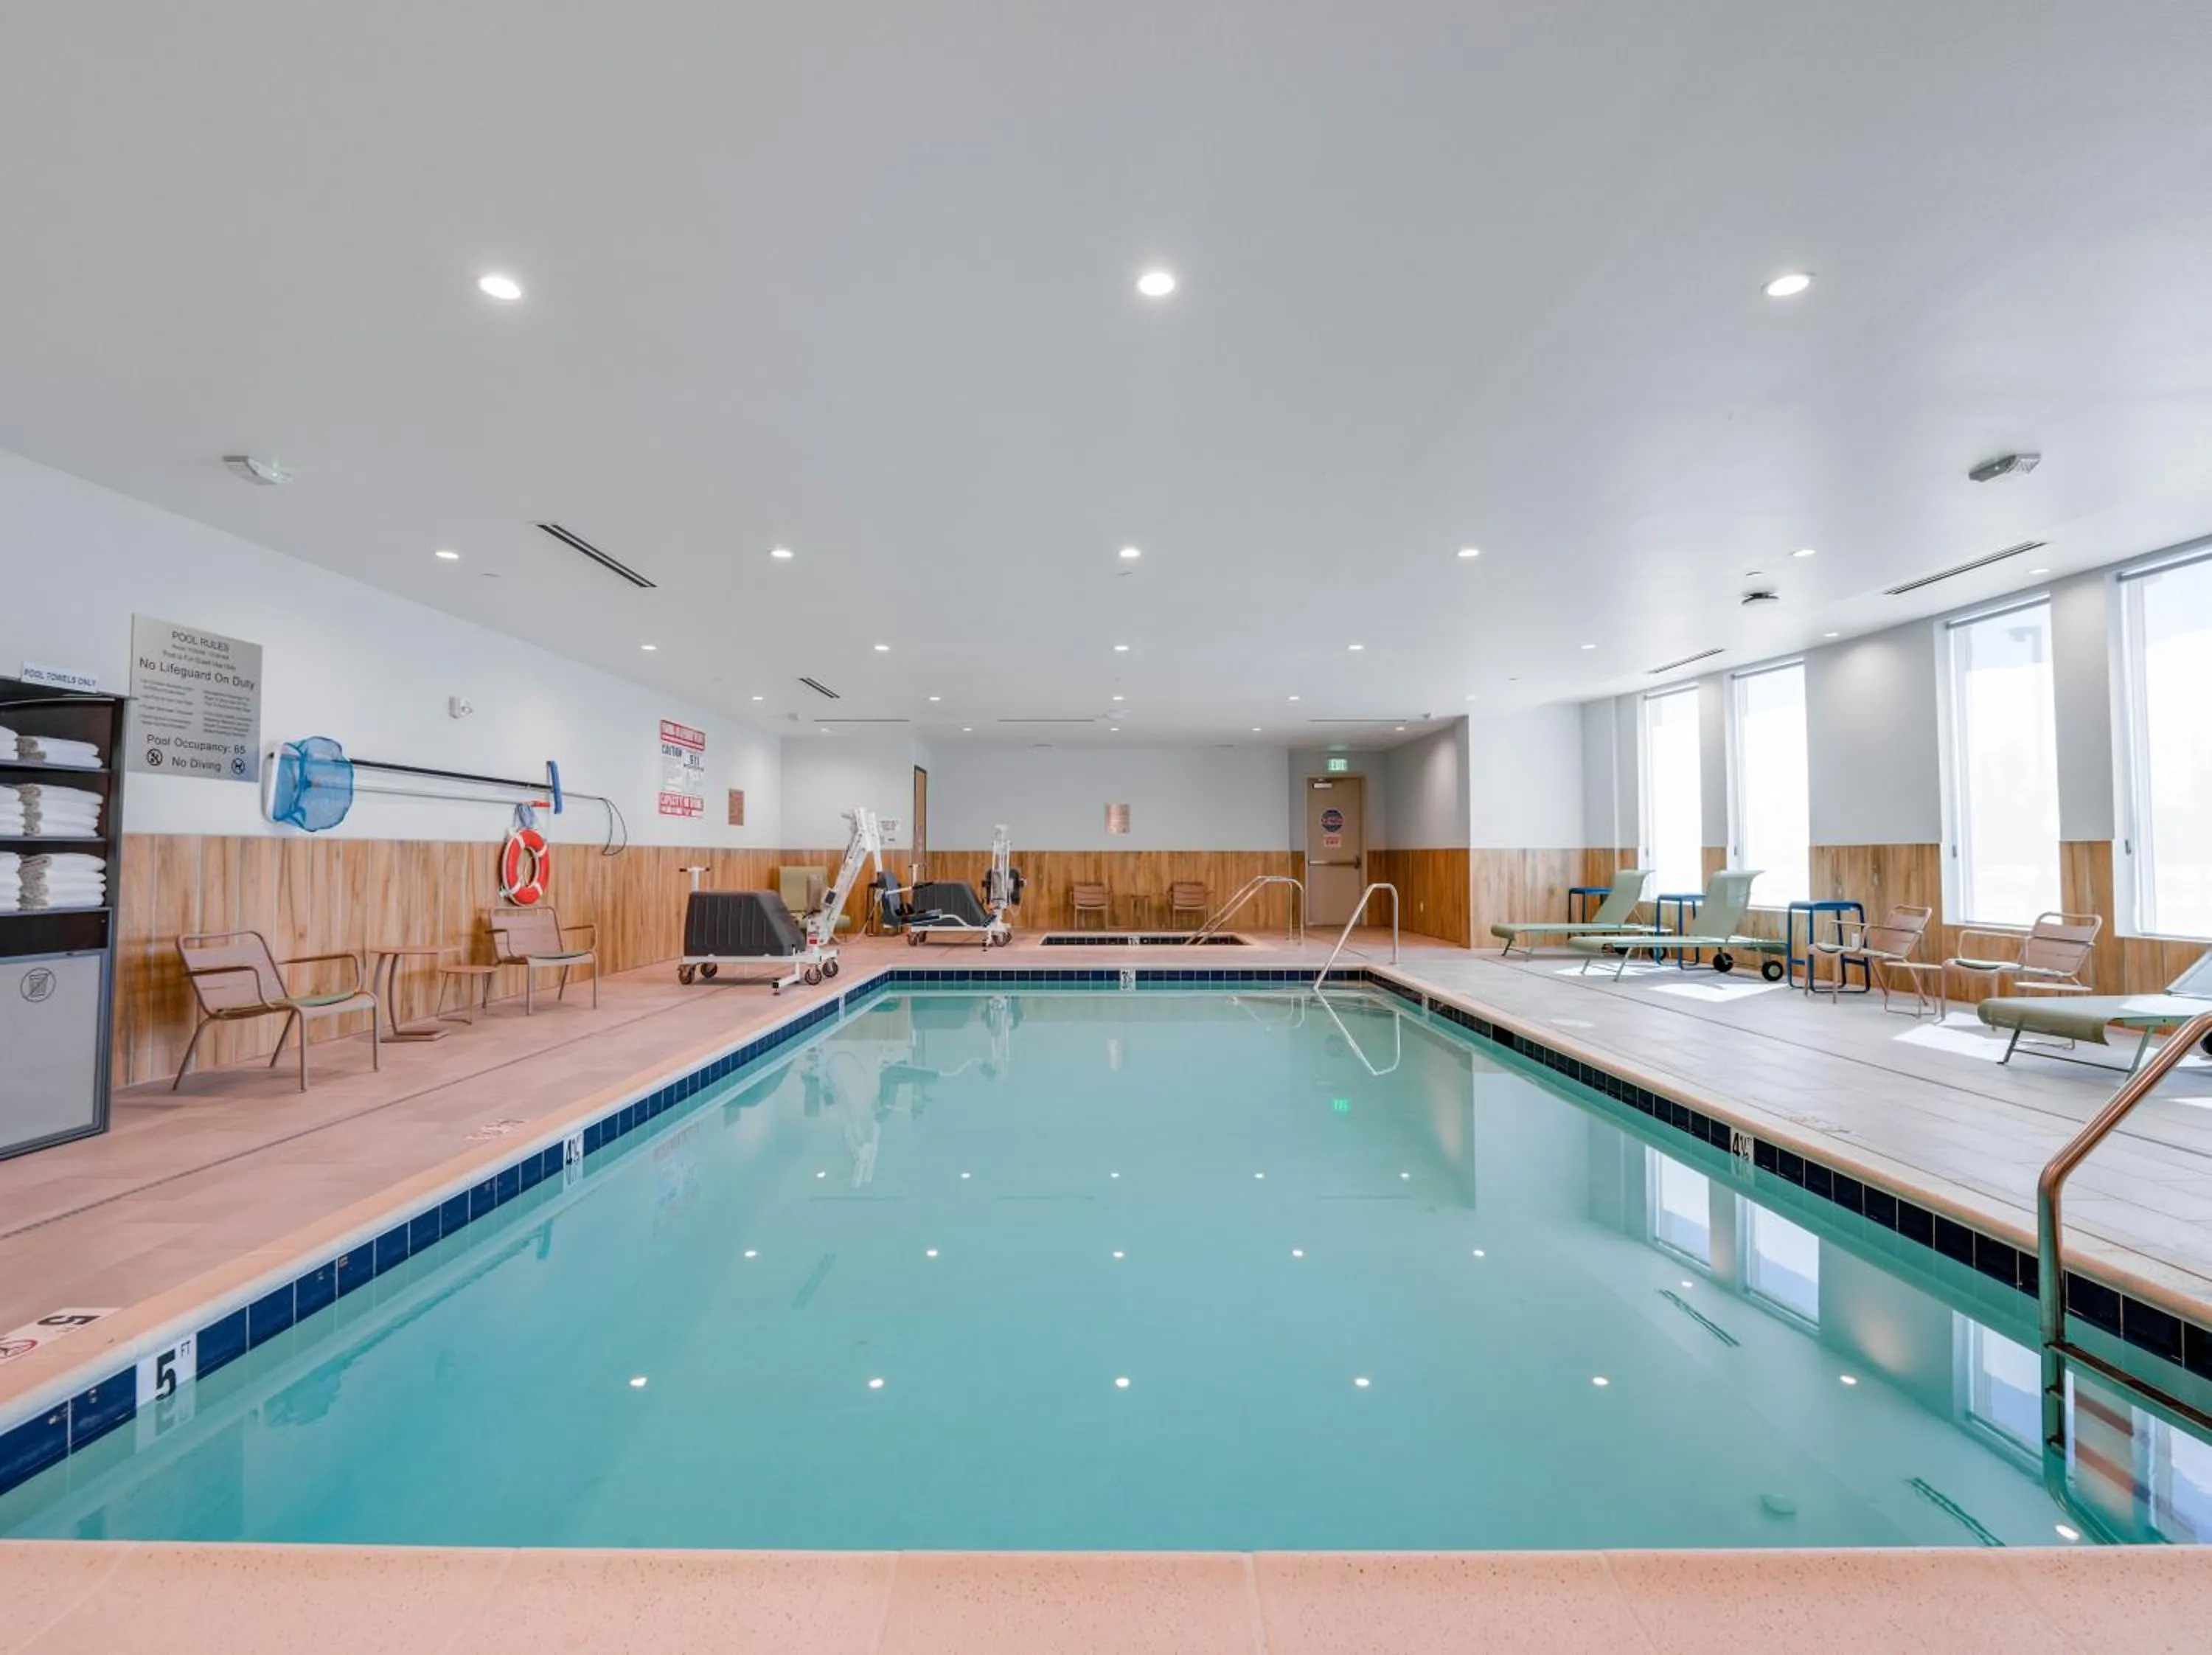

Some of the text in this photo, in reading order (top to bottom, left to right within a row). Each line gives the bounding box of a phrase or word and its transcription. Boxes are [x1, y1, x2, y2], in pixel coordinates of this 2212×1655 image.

[172, 631, 198, 645] POOL
[200, 638, 230, 653] RULES
[24, 668, 96, 687] POOL TOWELS ONLY
[139, 657, 256, 690] No Lifeguard On Duty
[146, 734, 171, 746] Pool
[173, 737, 232, 754] Occupancy:
[171, 756, 222, 773] No Diving
[38, 1315, 102, 1326] 5
[155, 1340, 192, 1402] 5 FT
